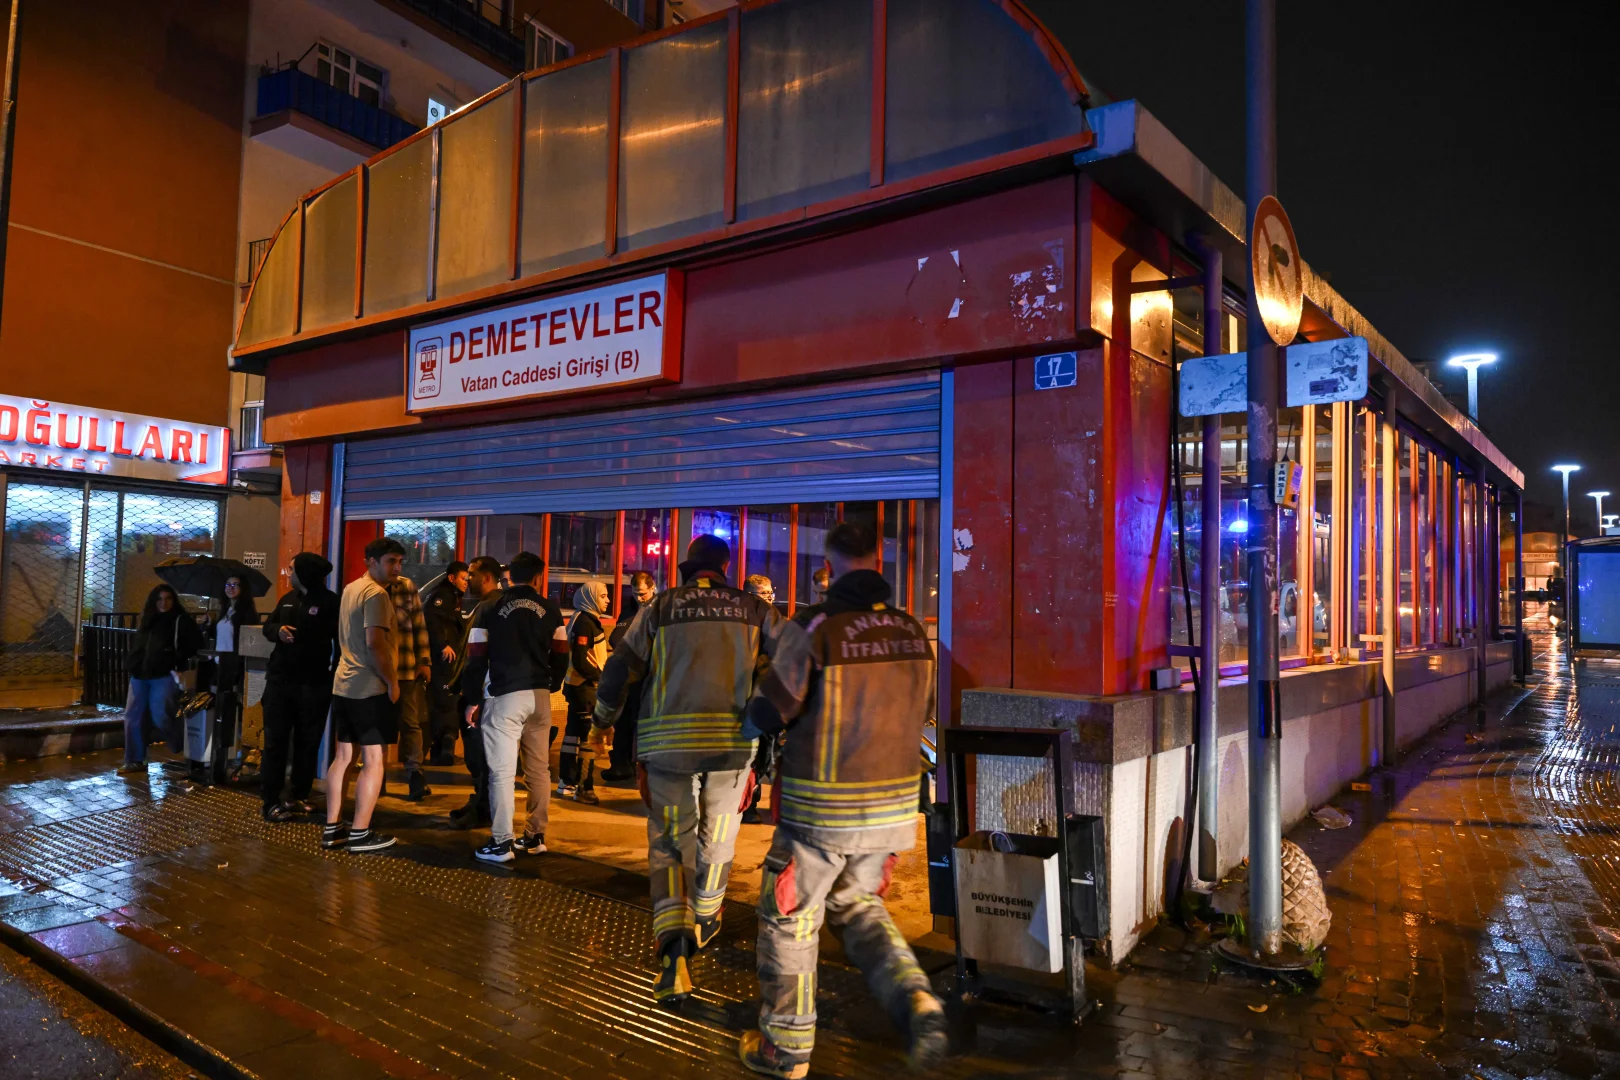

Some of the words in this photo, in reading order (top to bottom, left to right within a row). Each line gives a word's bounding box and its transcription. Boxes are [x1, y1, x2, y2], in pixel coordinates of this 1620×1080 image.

[449, 290, 662, 364] DEMETEVLER
[461, 375, 497, 393] Vatan
[502, 365, 561, 387] Caddesi
[566, 353, 609, 378] Girişi
[615, 349, 639, 375] (B)
[1047, 357, 1062, 375] 17
[418, 384, 436, 394] METRO
[1050, 376, 1058, 387] A
[0, 400, 209, 464] OĞULLARI
[674, 589, 741, 607] ANKARA
[843, 613, 917, 641] ANKARA
[841, 638, 926, 658] İTFAİYESİ
[971, 892, 1034, 908] BÜYÜKŞEHİR
[975, 905, 1031, 920] BELEDİYESİ
